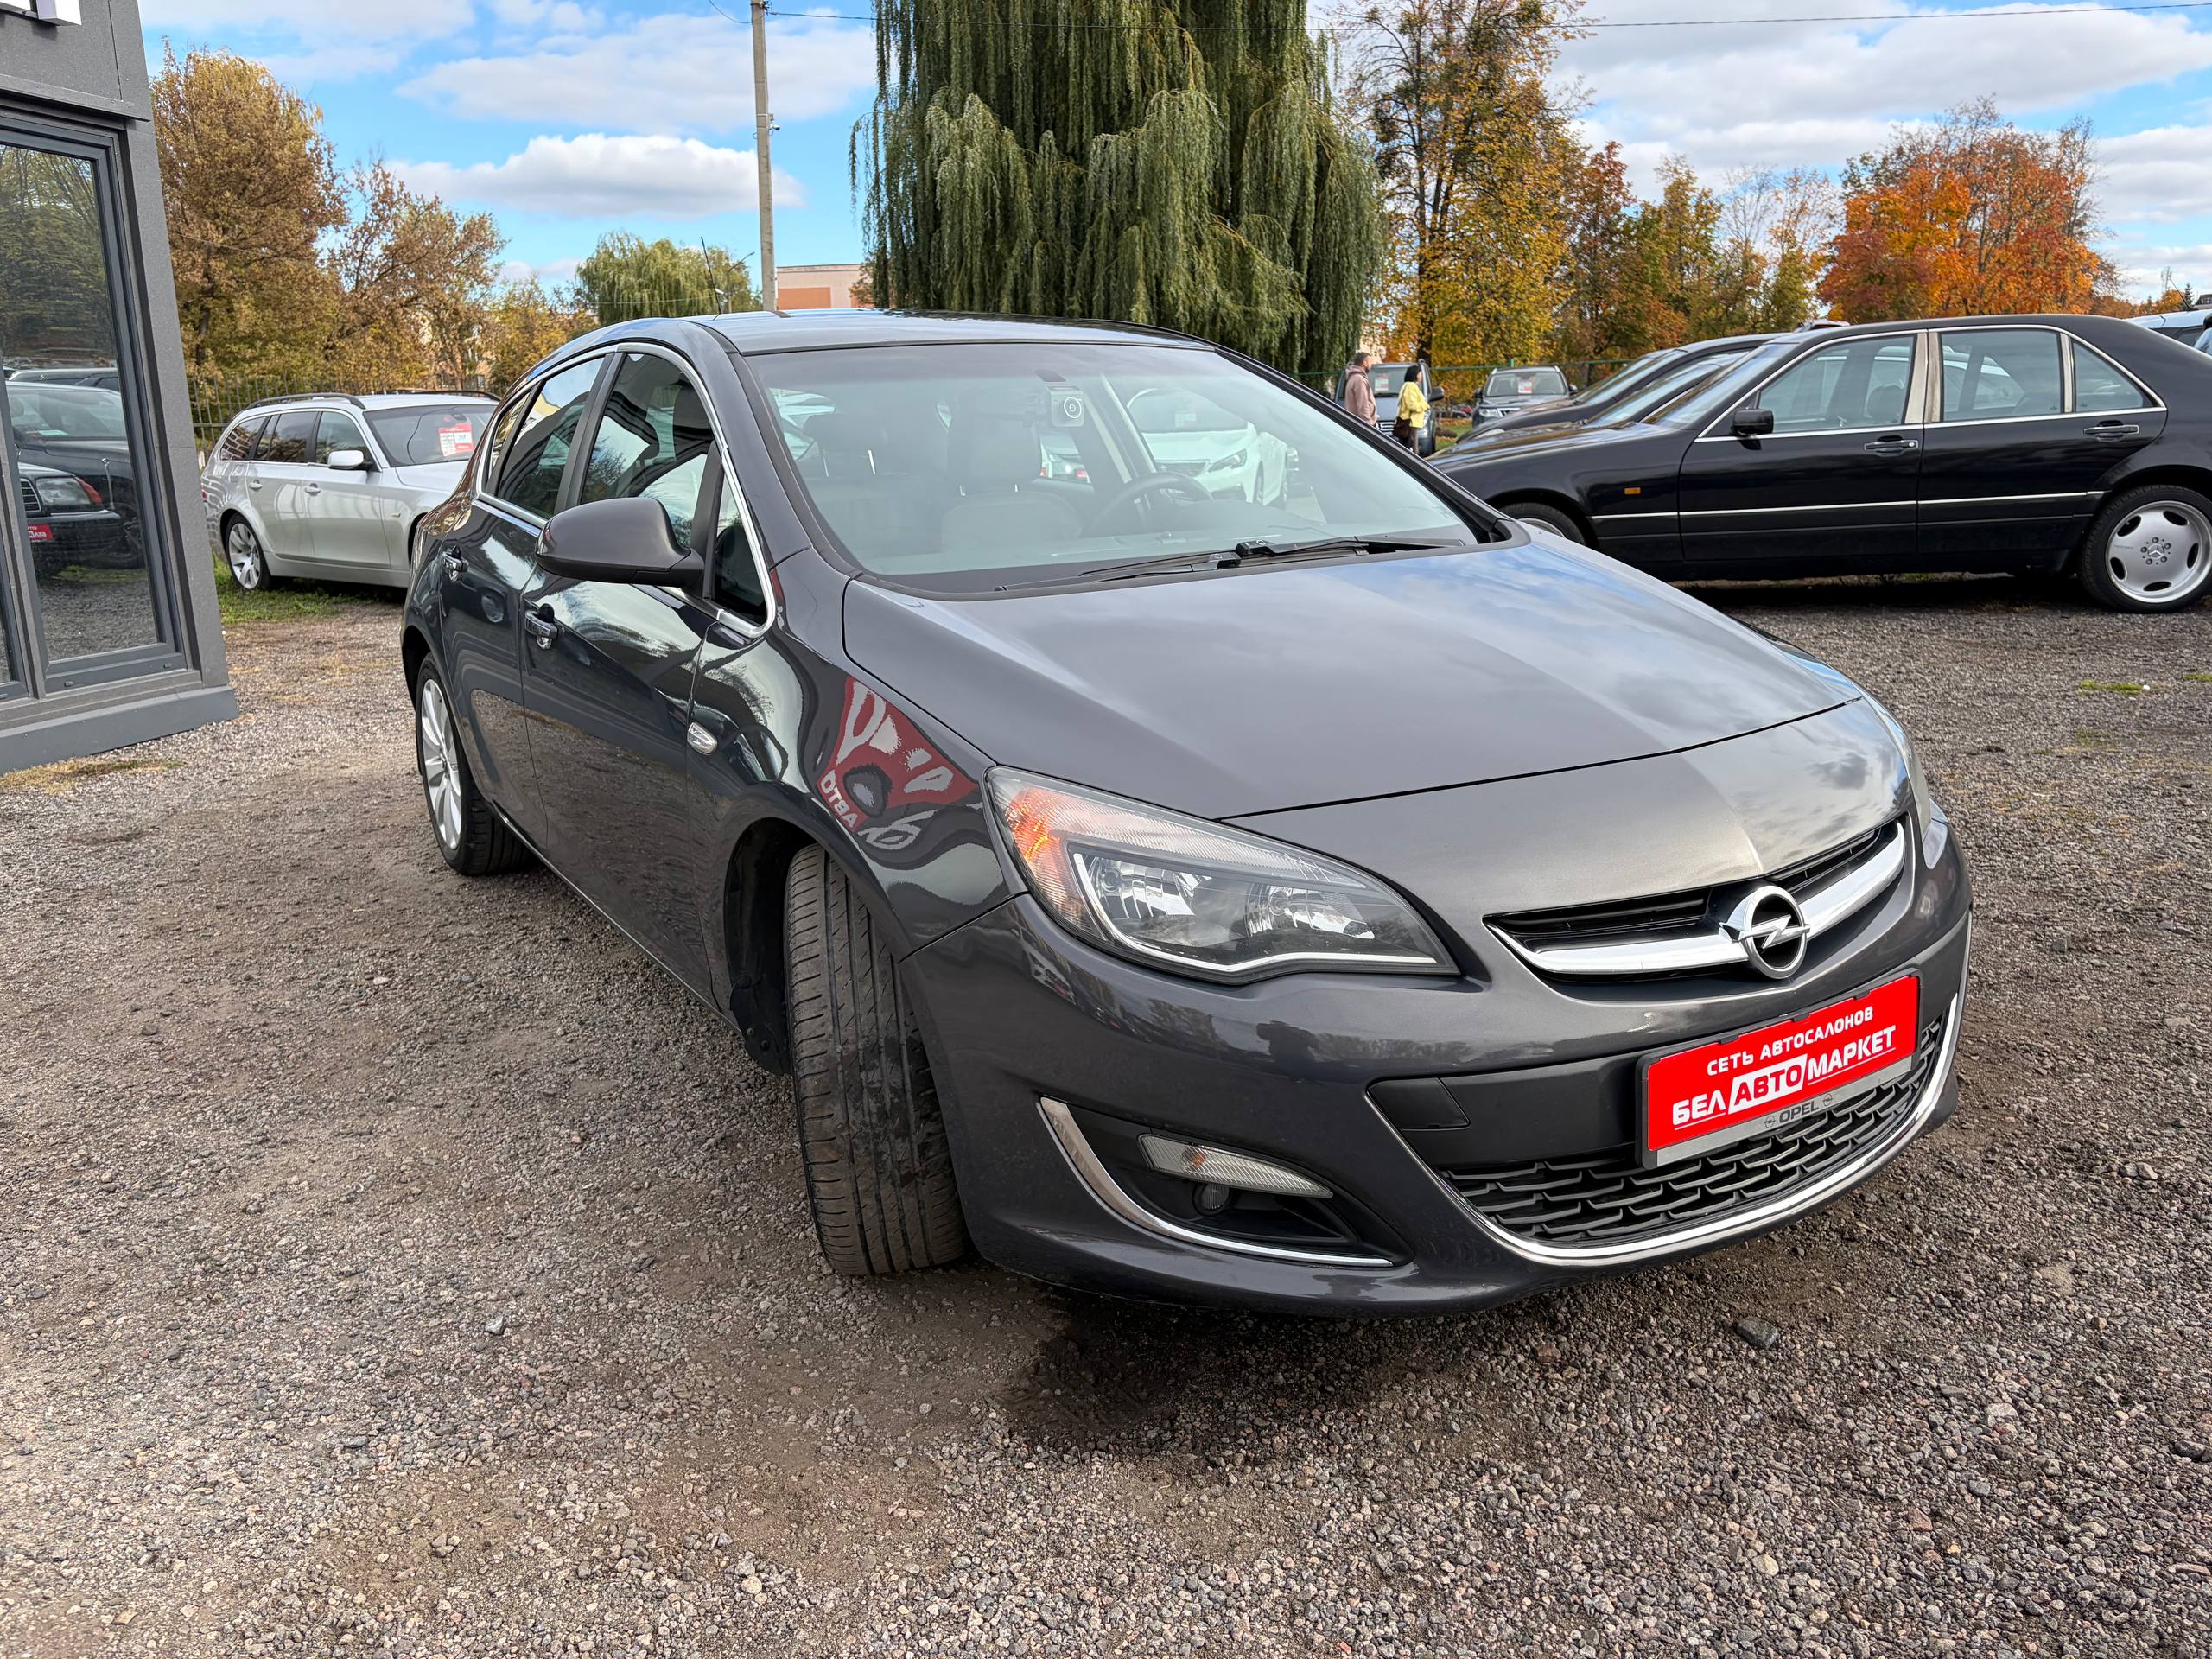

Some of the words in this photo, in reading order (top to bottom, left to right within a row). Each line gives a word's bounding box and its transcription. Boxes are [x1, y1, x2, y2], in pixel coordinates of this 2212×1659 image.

[1707, 1051, 1754, 1077] СЕТЬ
[1760, 1007, 1873, 1060] АВТОСАЛОНОВ
[1778, 1101, 1820, 1124] OPEL
